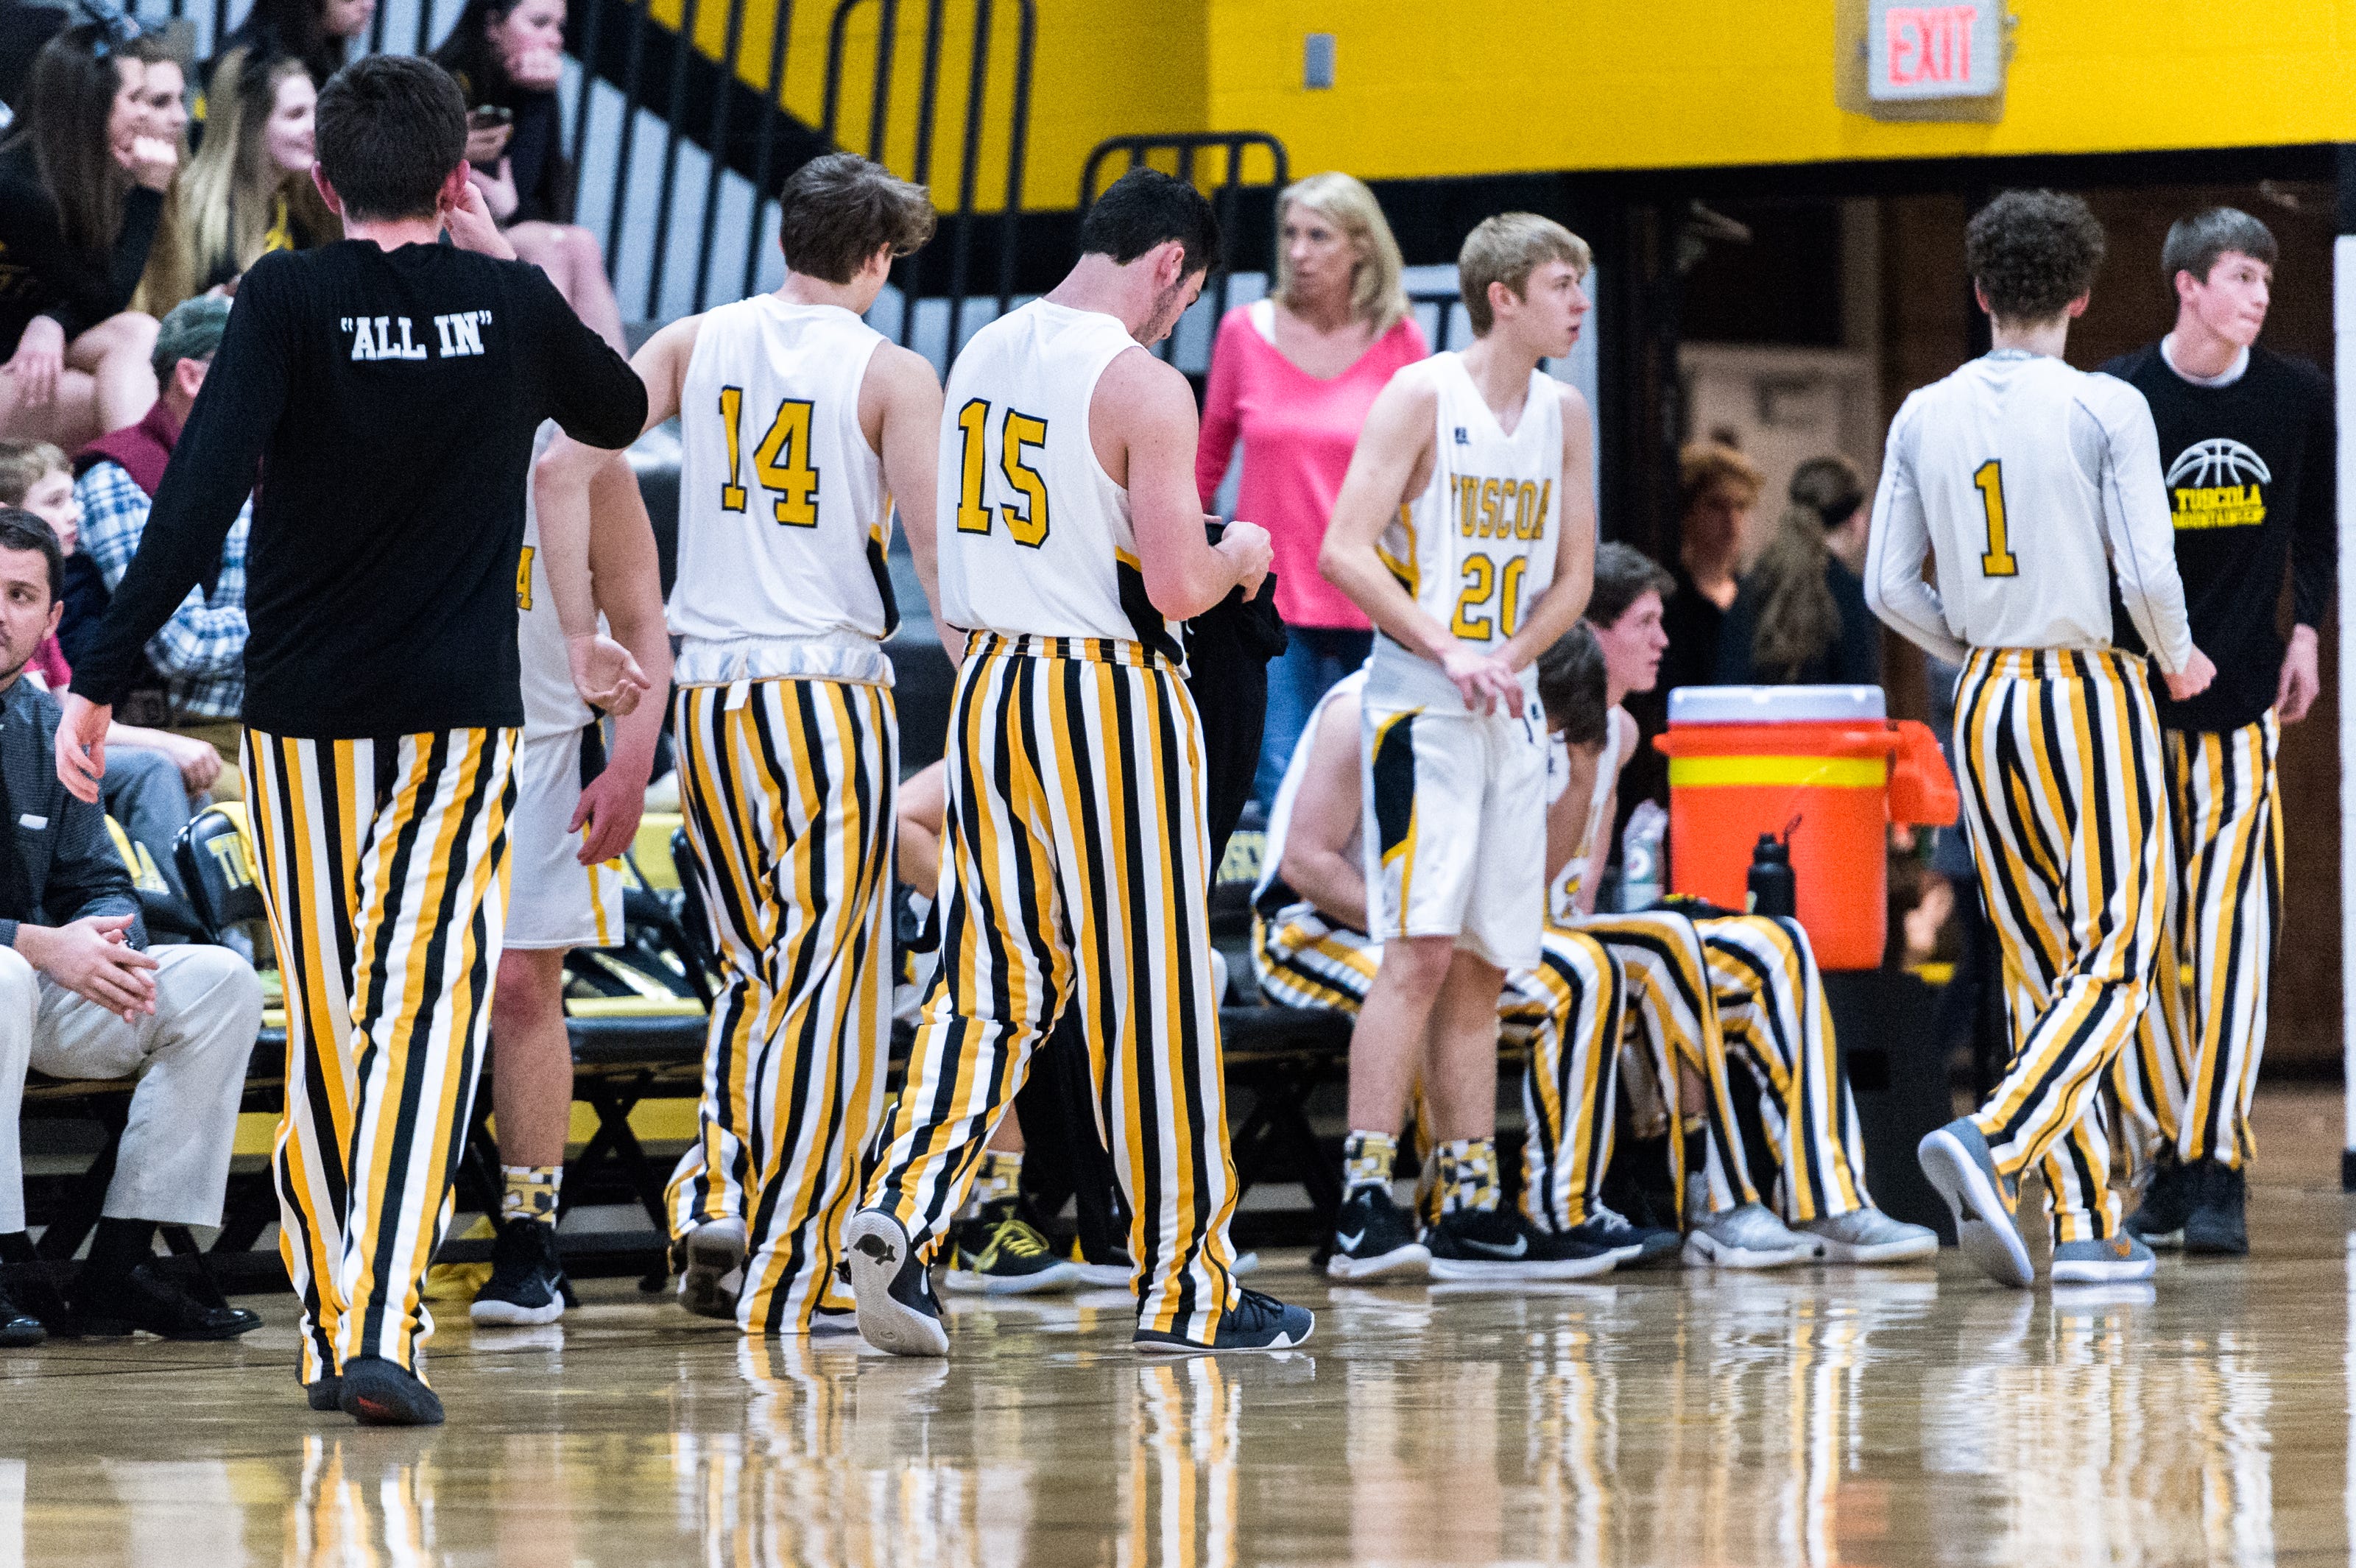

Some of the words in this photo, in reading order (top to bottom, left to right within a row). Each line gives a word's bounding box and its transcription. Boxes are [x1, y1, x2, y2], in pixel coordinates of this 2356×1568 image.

[1886, 6, 1978, 87] EXIT
[719, 384, 819, 528] 14
[957, 397, 1051, 549] 15
[1973, 458, 2020, 577] 1
